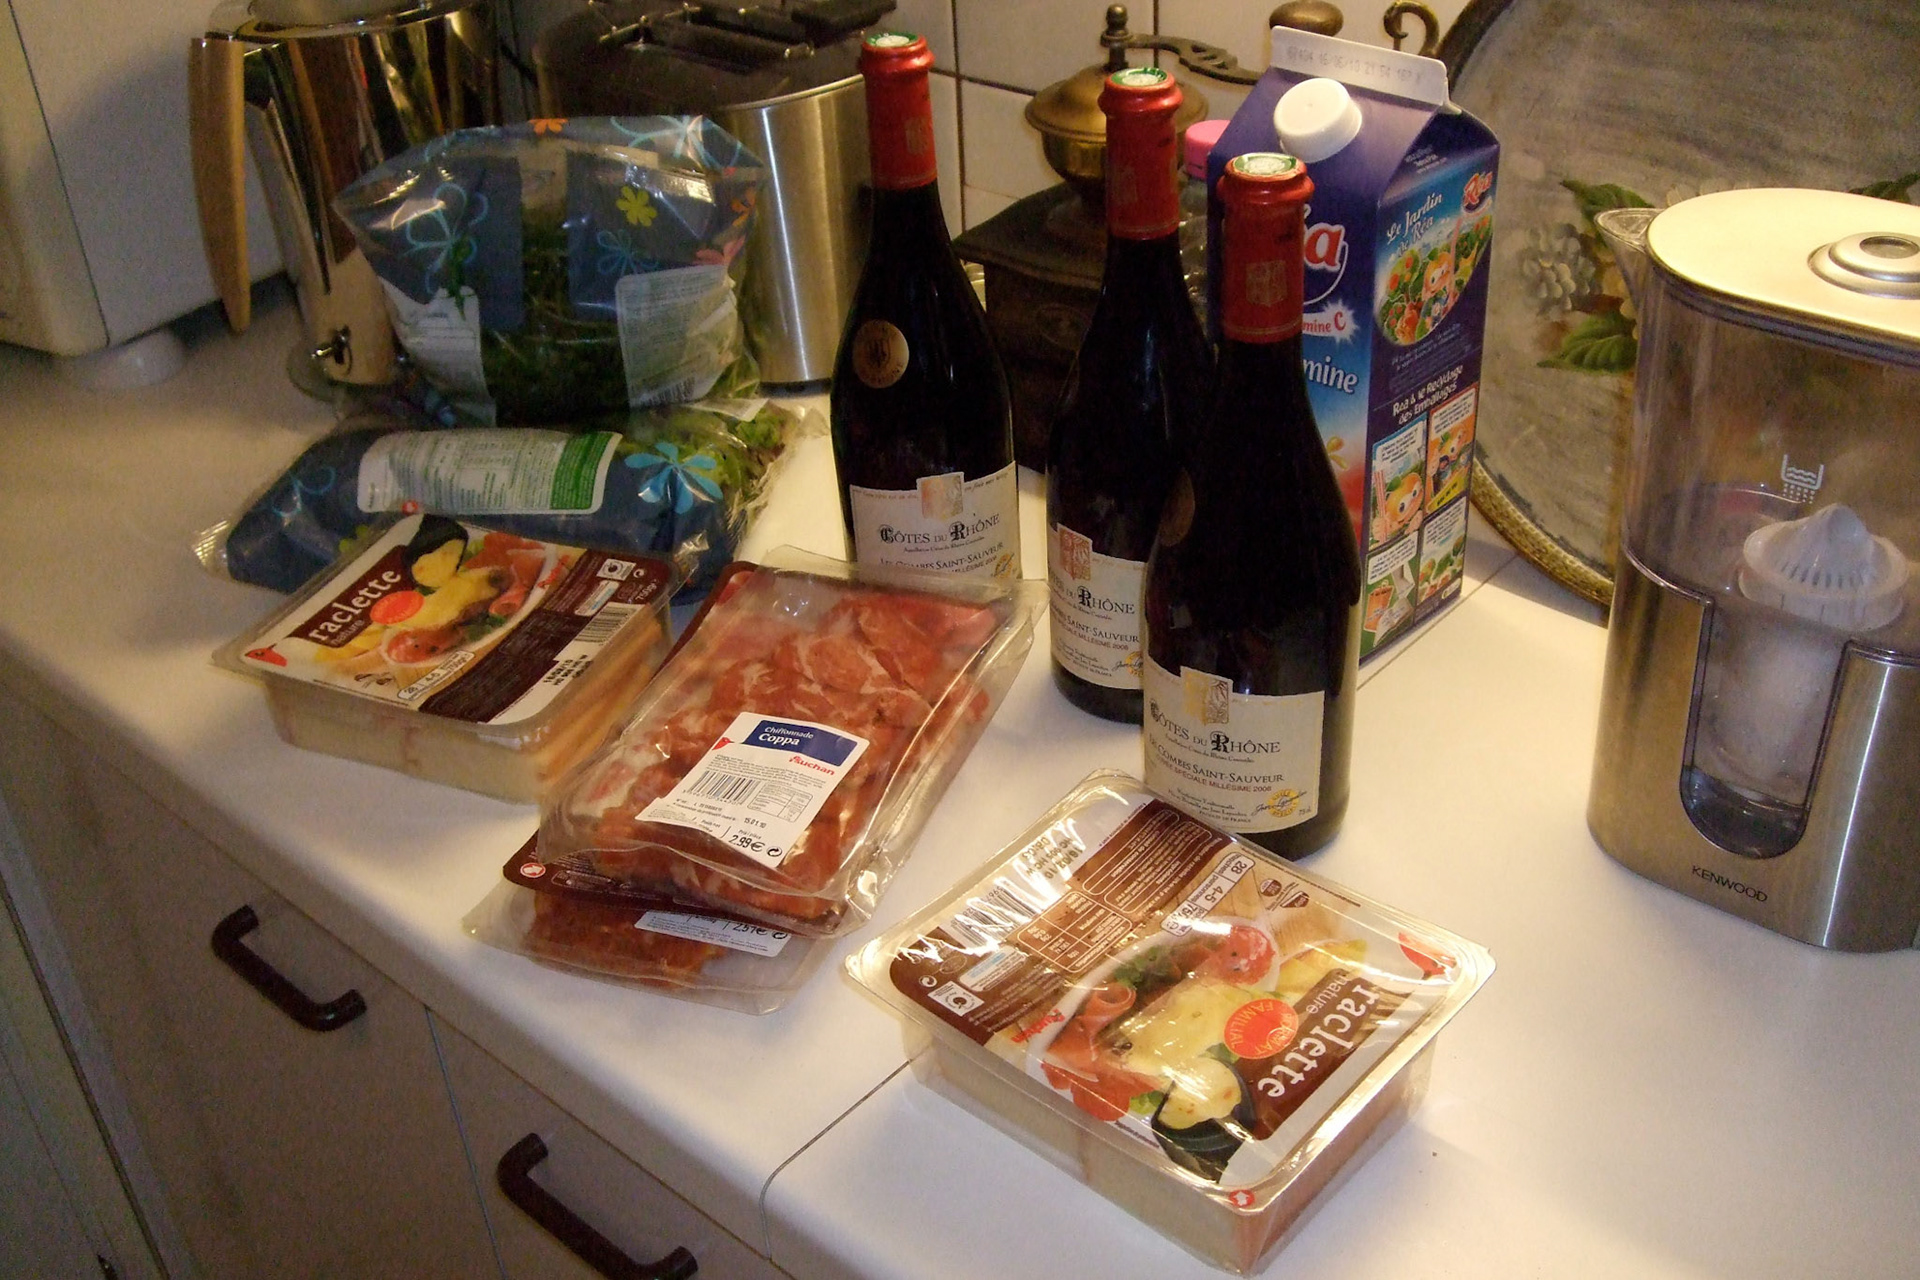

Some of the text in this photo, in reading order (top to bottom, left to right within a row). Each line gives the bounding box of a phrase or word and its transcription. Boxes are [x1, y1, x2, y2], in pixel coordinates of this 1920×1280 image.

[1386, 222, 1401, 245] Le
[1403, 192, 1442, 238] Jardin
[1303, 319, 1331, 332] mine
[1303, 355, 1358, 393] mine
[1427, 365, 1463, 393] Recyclage
[1414, 381, 1457, 415] Emballages
[879, 513, 1000, 544] CÔTES DU RHÔNE
[935, 542, 1004, 570] SAINT-SAUVEUR
[309, 571, 401, 641] raclette
[1077, 586, 1135, 614] RHÔNE
[1067, 615, 1140, 643] SAINT-SAUVEUR
[759, 733, 800, 746] Coppa
[764, 726, 814, 739] Chiffonnade
[1150, 698, 1281, 754] CÔTES DU RHÔNE
[789, 755, 835, 776] Auchan
[1158, 744, 1191, 770] COMBES
[1192, 763, 1284, 784] SAINT-SAUVEUR
[1209, 780, 1251, 793] MILLÉSIME
[1230, 860, 1247, 875] 28
[1192, 874, 1218, 903] personnes
[1205, 885, 1223, 903] 4-5
[1692, 865, 1768, 902] KENWOOD
[1306, 974, 1350, 1014] nature
[1229, 1001, 1274, 1049] FAMILIAL
[1258, 984, 1379, 1097] raclette
